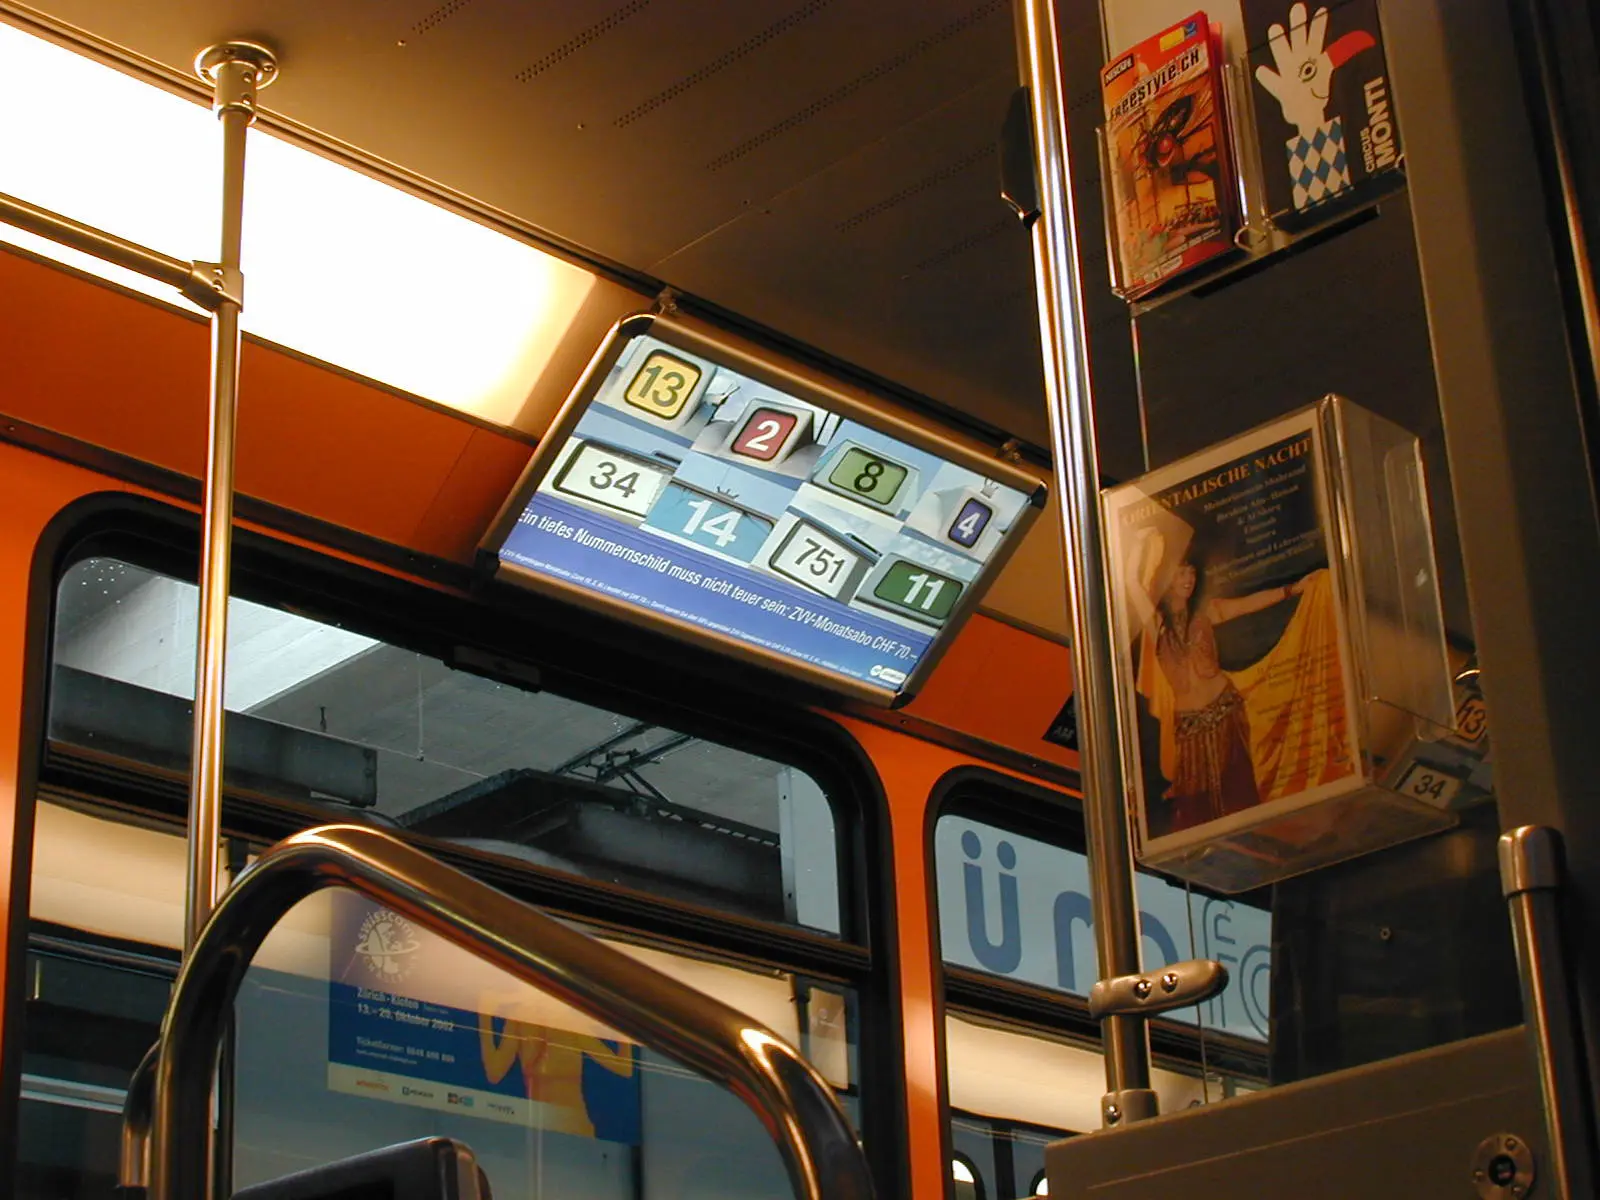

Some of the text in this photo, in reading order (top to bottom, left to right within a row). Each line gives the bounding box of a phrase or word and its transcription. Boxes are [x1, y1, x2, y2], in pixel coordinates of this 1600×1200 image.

[1363, 77, 1396, 168] MONTI
[1360, 128, 1375, 173] CIRCUS
[638, 365, 686, 408] 13
[745, 420, 780, 451] 2
[1255, 437, 1312, 472] NACHT
[589, 461, 640, 498] 34
[854, 461, 885, 492] 8
[681, 499, 743, 547] 14
[957, 512, 982, 539] 4
[794, 538, 845, 584] 751
[538, 516, 574, 538] tiefes
[573, 528, 671, 573] Nummernschild
[668, 563, 702, 585] muss
[701, 574, 733, 596] nicht
[731, 584, 762, 607] teuer
[761, 597, 791, 617] sein:
[788, 606, 873, 646] ZVV-Monatsabo
[872, 635, 897, 654] CHF
[903, 572, 946, 610] 11
[1463, 707, 1486, 734] 13
[1414, 774, 1447, 799] 34
